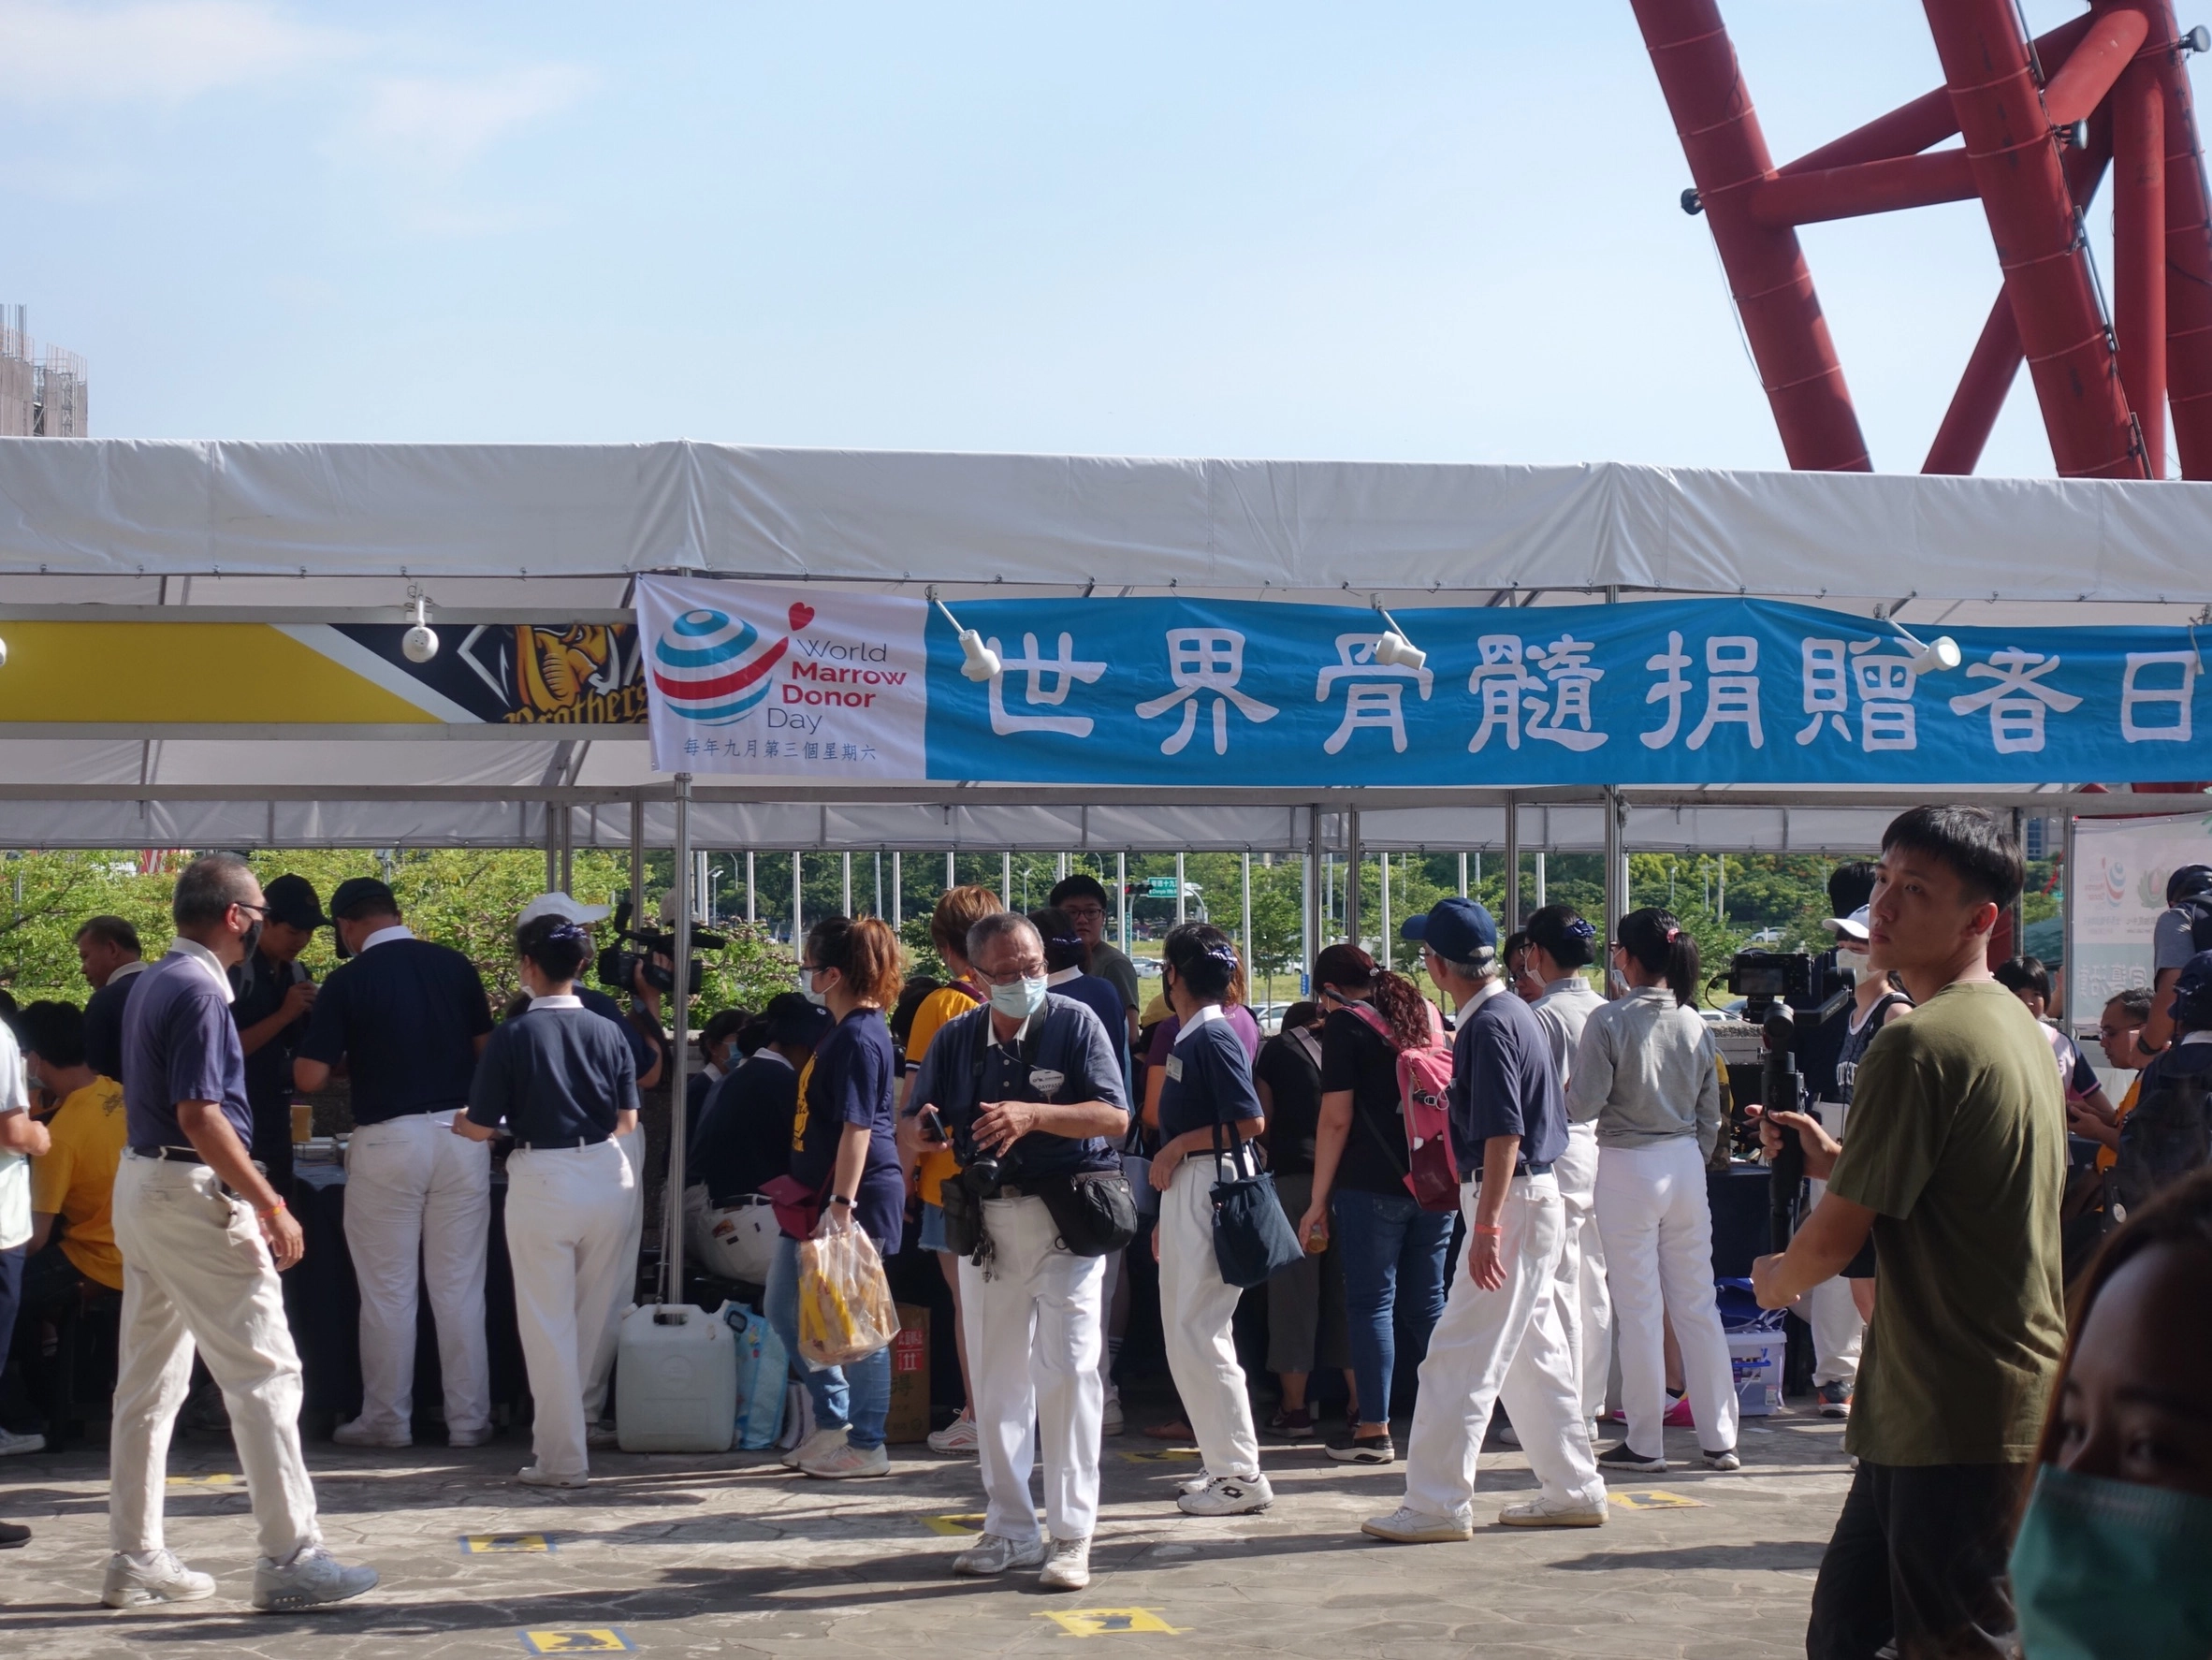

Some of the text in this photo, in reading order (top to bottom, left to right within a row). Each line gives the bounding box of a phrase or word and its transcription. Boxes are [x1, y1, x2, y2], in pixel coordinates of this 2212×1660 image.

[797, 638, 886, 663] World
[792, 661, 907, 686] Marrow
[782, 684, 876, 708] Donor
[985, 628, 2198, 755] 世界骨髓捐贈者日
[767, 707, 822, 735] Day
[683, 737, 876, 762] 每年九月第三個星期六
